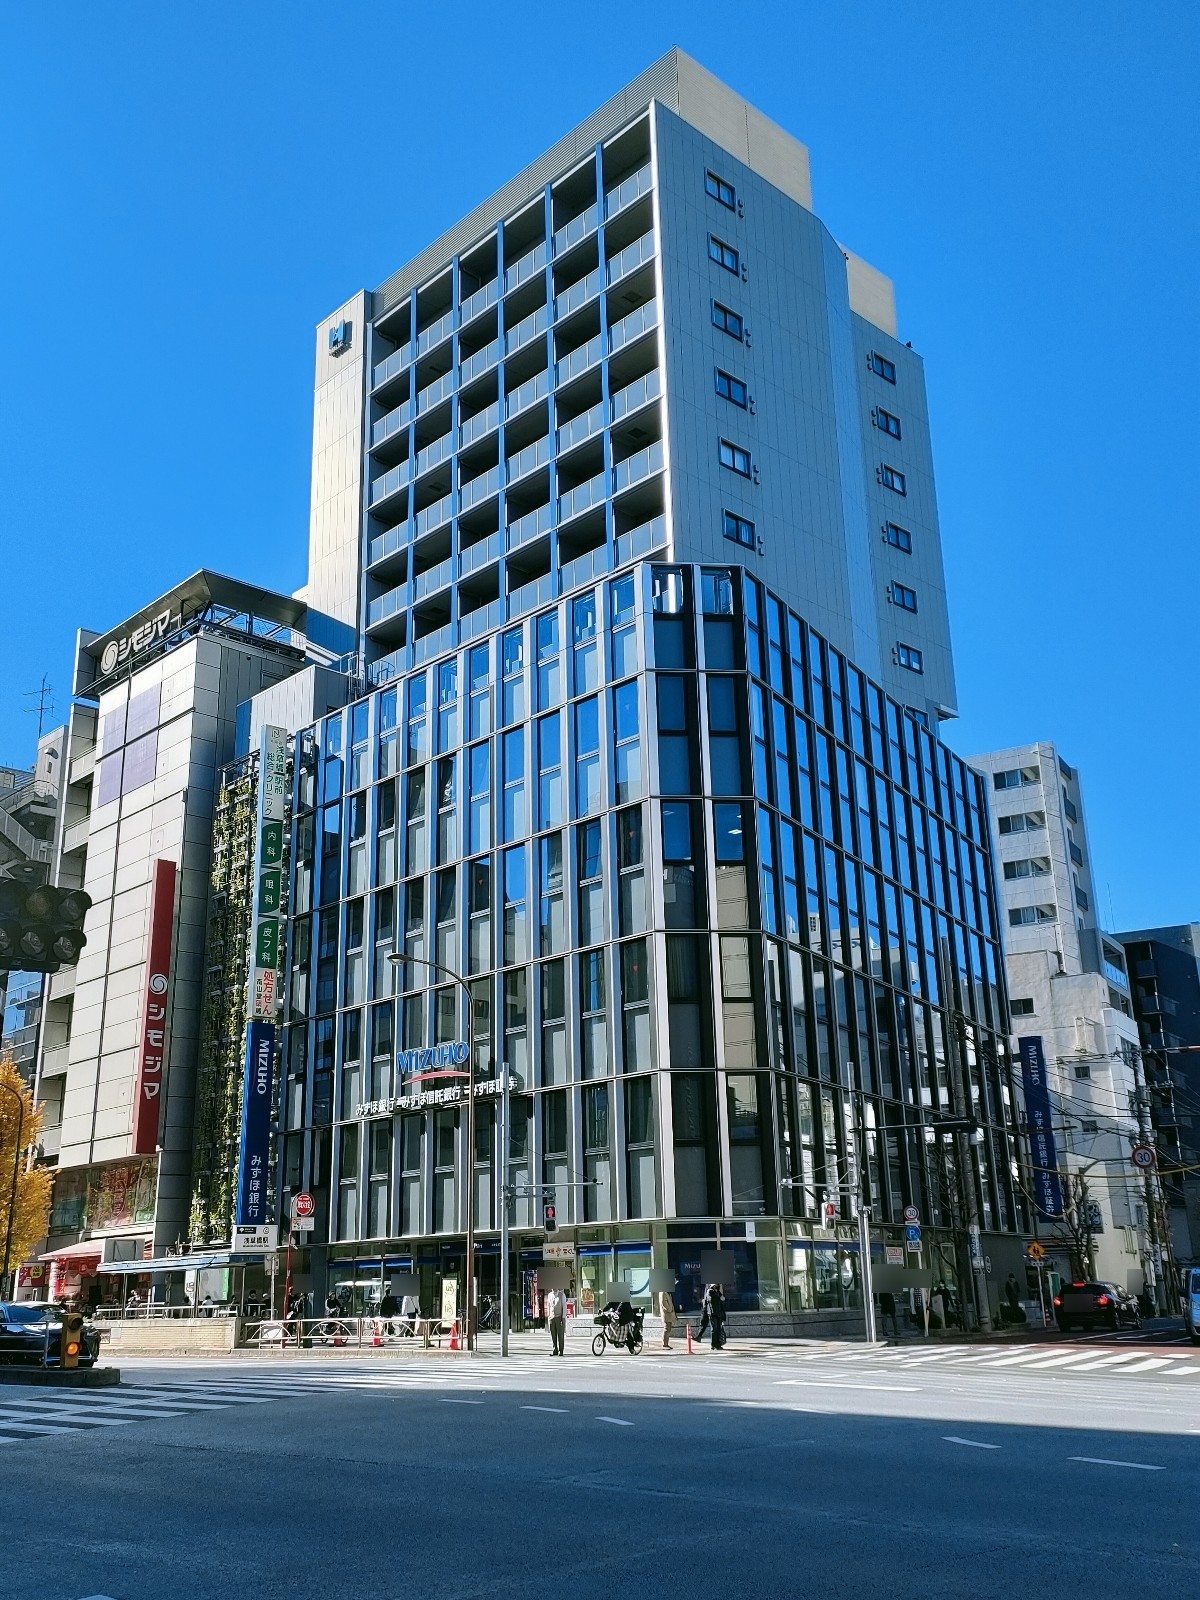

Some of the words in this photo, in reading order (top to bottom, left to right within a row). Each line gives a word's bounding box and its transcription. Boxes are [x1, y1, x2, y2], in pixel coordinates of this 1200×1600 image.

[118, 608, 171, 662] シモジマ
[264, 752, 275, 816] 総合クリニック
[266, 831, 277, 857] 内科
[264, 880, 274, 905] 眼科
[261, 927, 273, 963] 皮フ科
[263, 970, 274, 1016] 処方せん
[143, 1003, 166, 1100] シモジマ
[256, 1039, 270, 1095] MIZUHO
[396, 1041, 470, 1075] MIZUHO
[1027, 1045, 1041, 1086] MIZUHO
[355, 1097, 395, 1116] みずほ銀行
[401, 1085, 461, 1109] みずほ信託銀行
[1137, 1152, 1150, 1163] 30
[248, 1155, 262, 1218] みずほ銀行
[907, 1209, 916, 1217] 30
